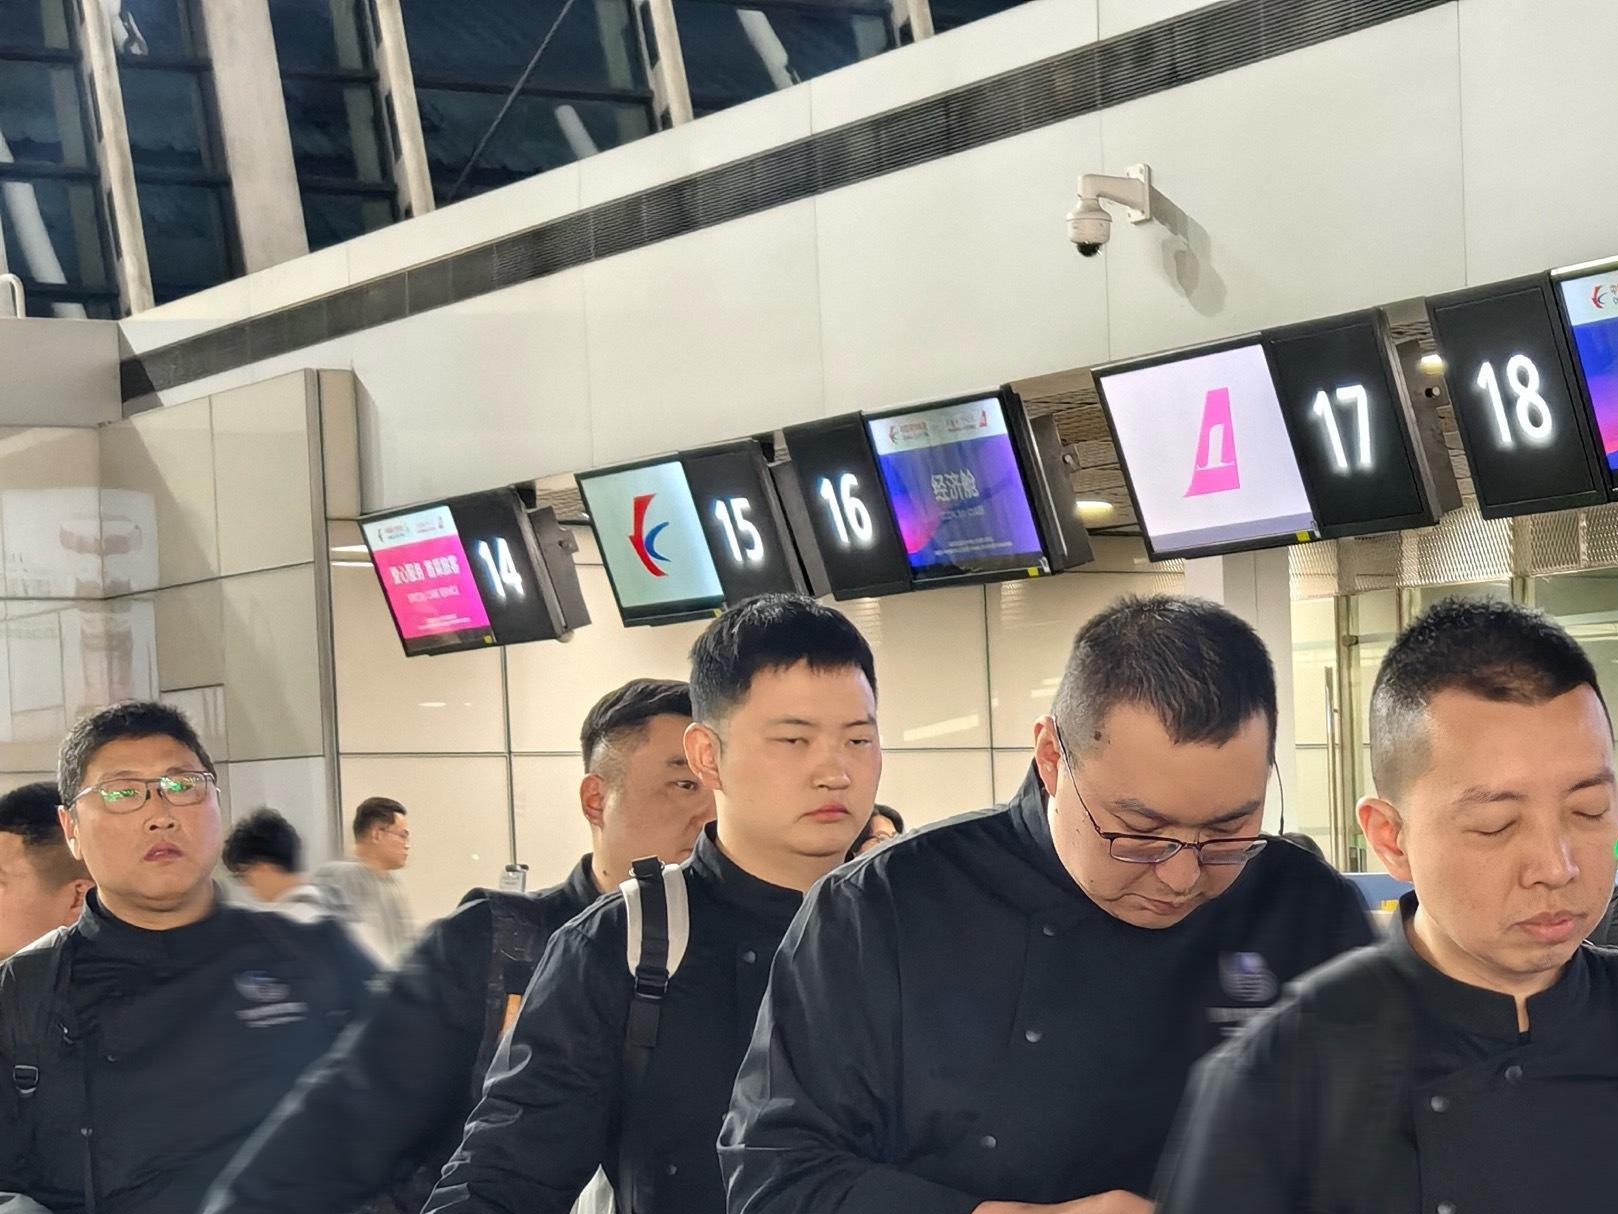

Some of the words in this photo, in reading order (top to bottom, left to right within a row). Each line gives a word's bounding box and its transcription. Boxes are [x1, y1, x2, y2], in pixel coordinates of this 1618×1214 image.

[1313, 383, 1372, 470] 17
[1476, 353, 1552, 448] 18
[713, 497, 764, 563] 15
[820, 472, 873, 545] 16
[478, 536, 525, 599] 14
